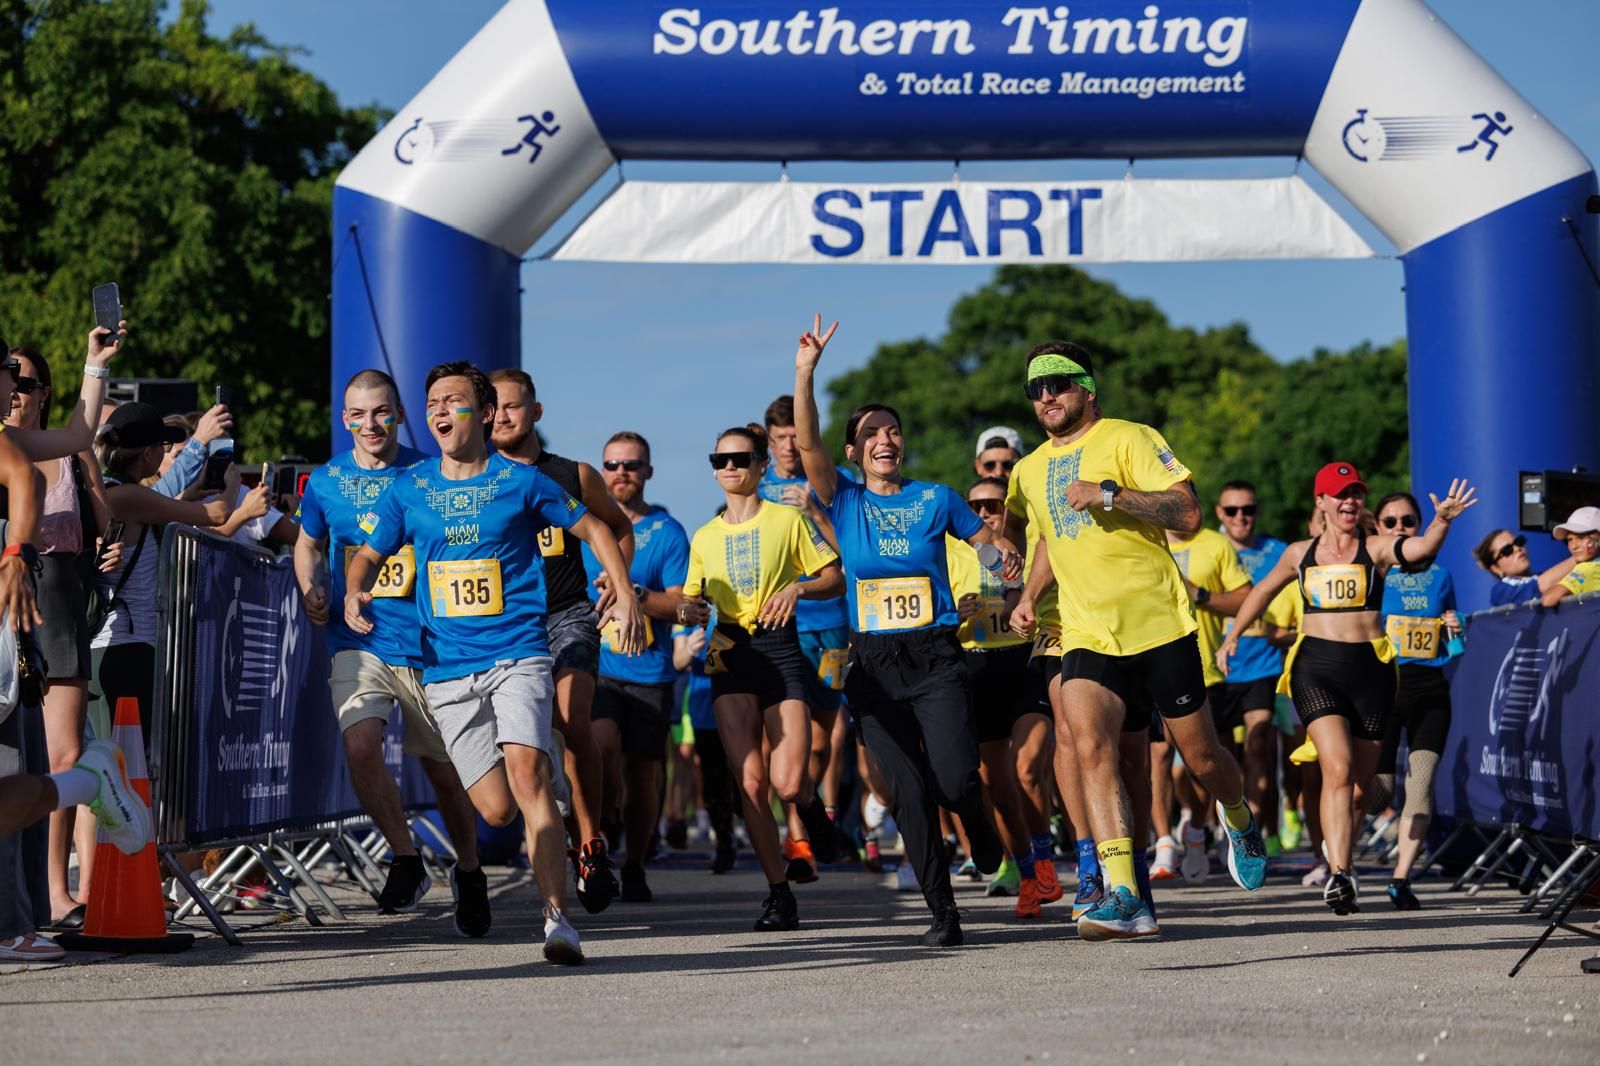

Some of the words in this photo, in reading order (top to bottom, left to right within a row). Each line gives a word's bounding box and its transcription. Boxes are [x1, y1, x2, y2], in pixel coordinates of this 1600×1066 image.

[653, 6, 976, 56] Southern
[1001, 5, 1249, 68] Timing
[859, 72, 889, 96] &
[896, 71, 974, 96] Total
[979, 71, 1051, 96] Race
[1058, 70, 1247, 100] Management
[809, 187, 1104, 258] START
[444, 523, 480, 537] MIAMI
[447, 532, 480, 546] 2024
[878, 537, 910, 549] MIAMI
[879, 545, 910, 556] 2024
[377, 561, 405, 588] 33
[449, 577, 491, 606] 135
[1325, 578, 1357, 600] 108
[883, 593, 921, 621] 139
[1406, 630, 1433, 651] 132
